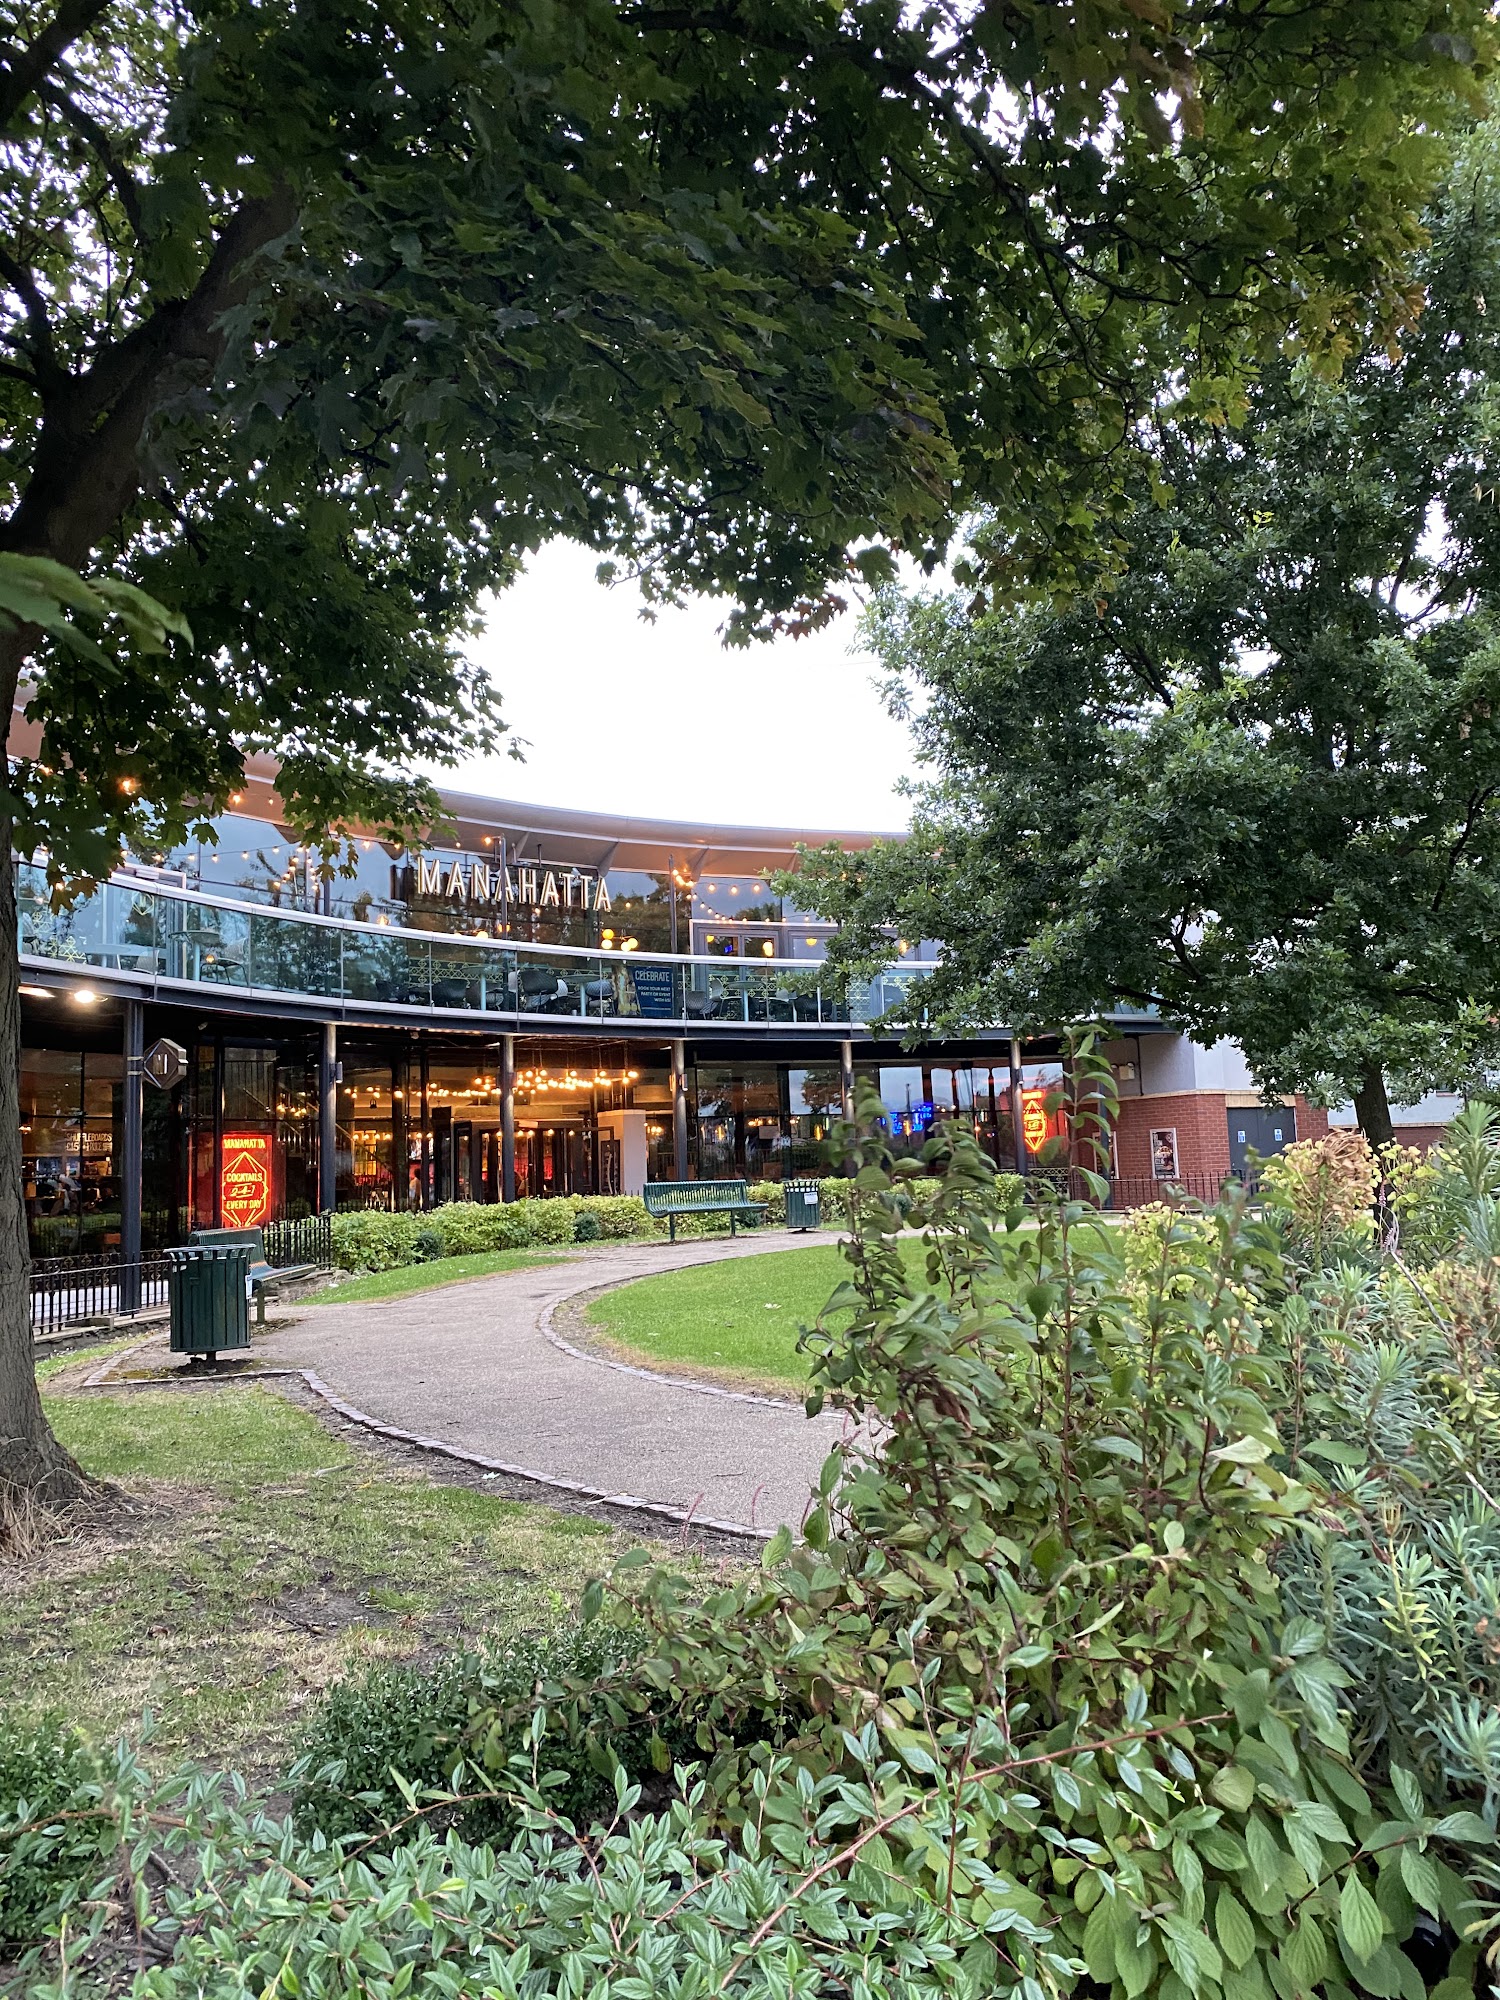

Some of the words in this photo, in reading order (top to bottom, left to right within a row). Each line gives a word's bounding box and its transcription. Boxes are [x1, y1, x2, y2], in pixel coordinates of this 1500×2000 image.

[417, 856, 612, 912] MANAHATTA
[634, 970, 670, 982] CELEBRATE
[223, 1138, 266, 1149] MANAHATTA
[226, 1172, 263, 1182] COCKTAILS
[226, 1200, 247, 1210] EVERY
[249, 1199, 262, 1209] DAY
